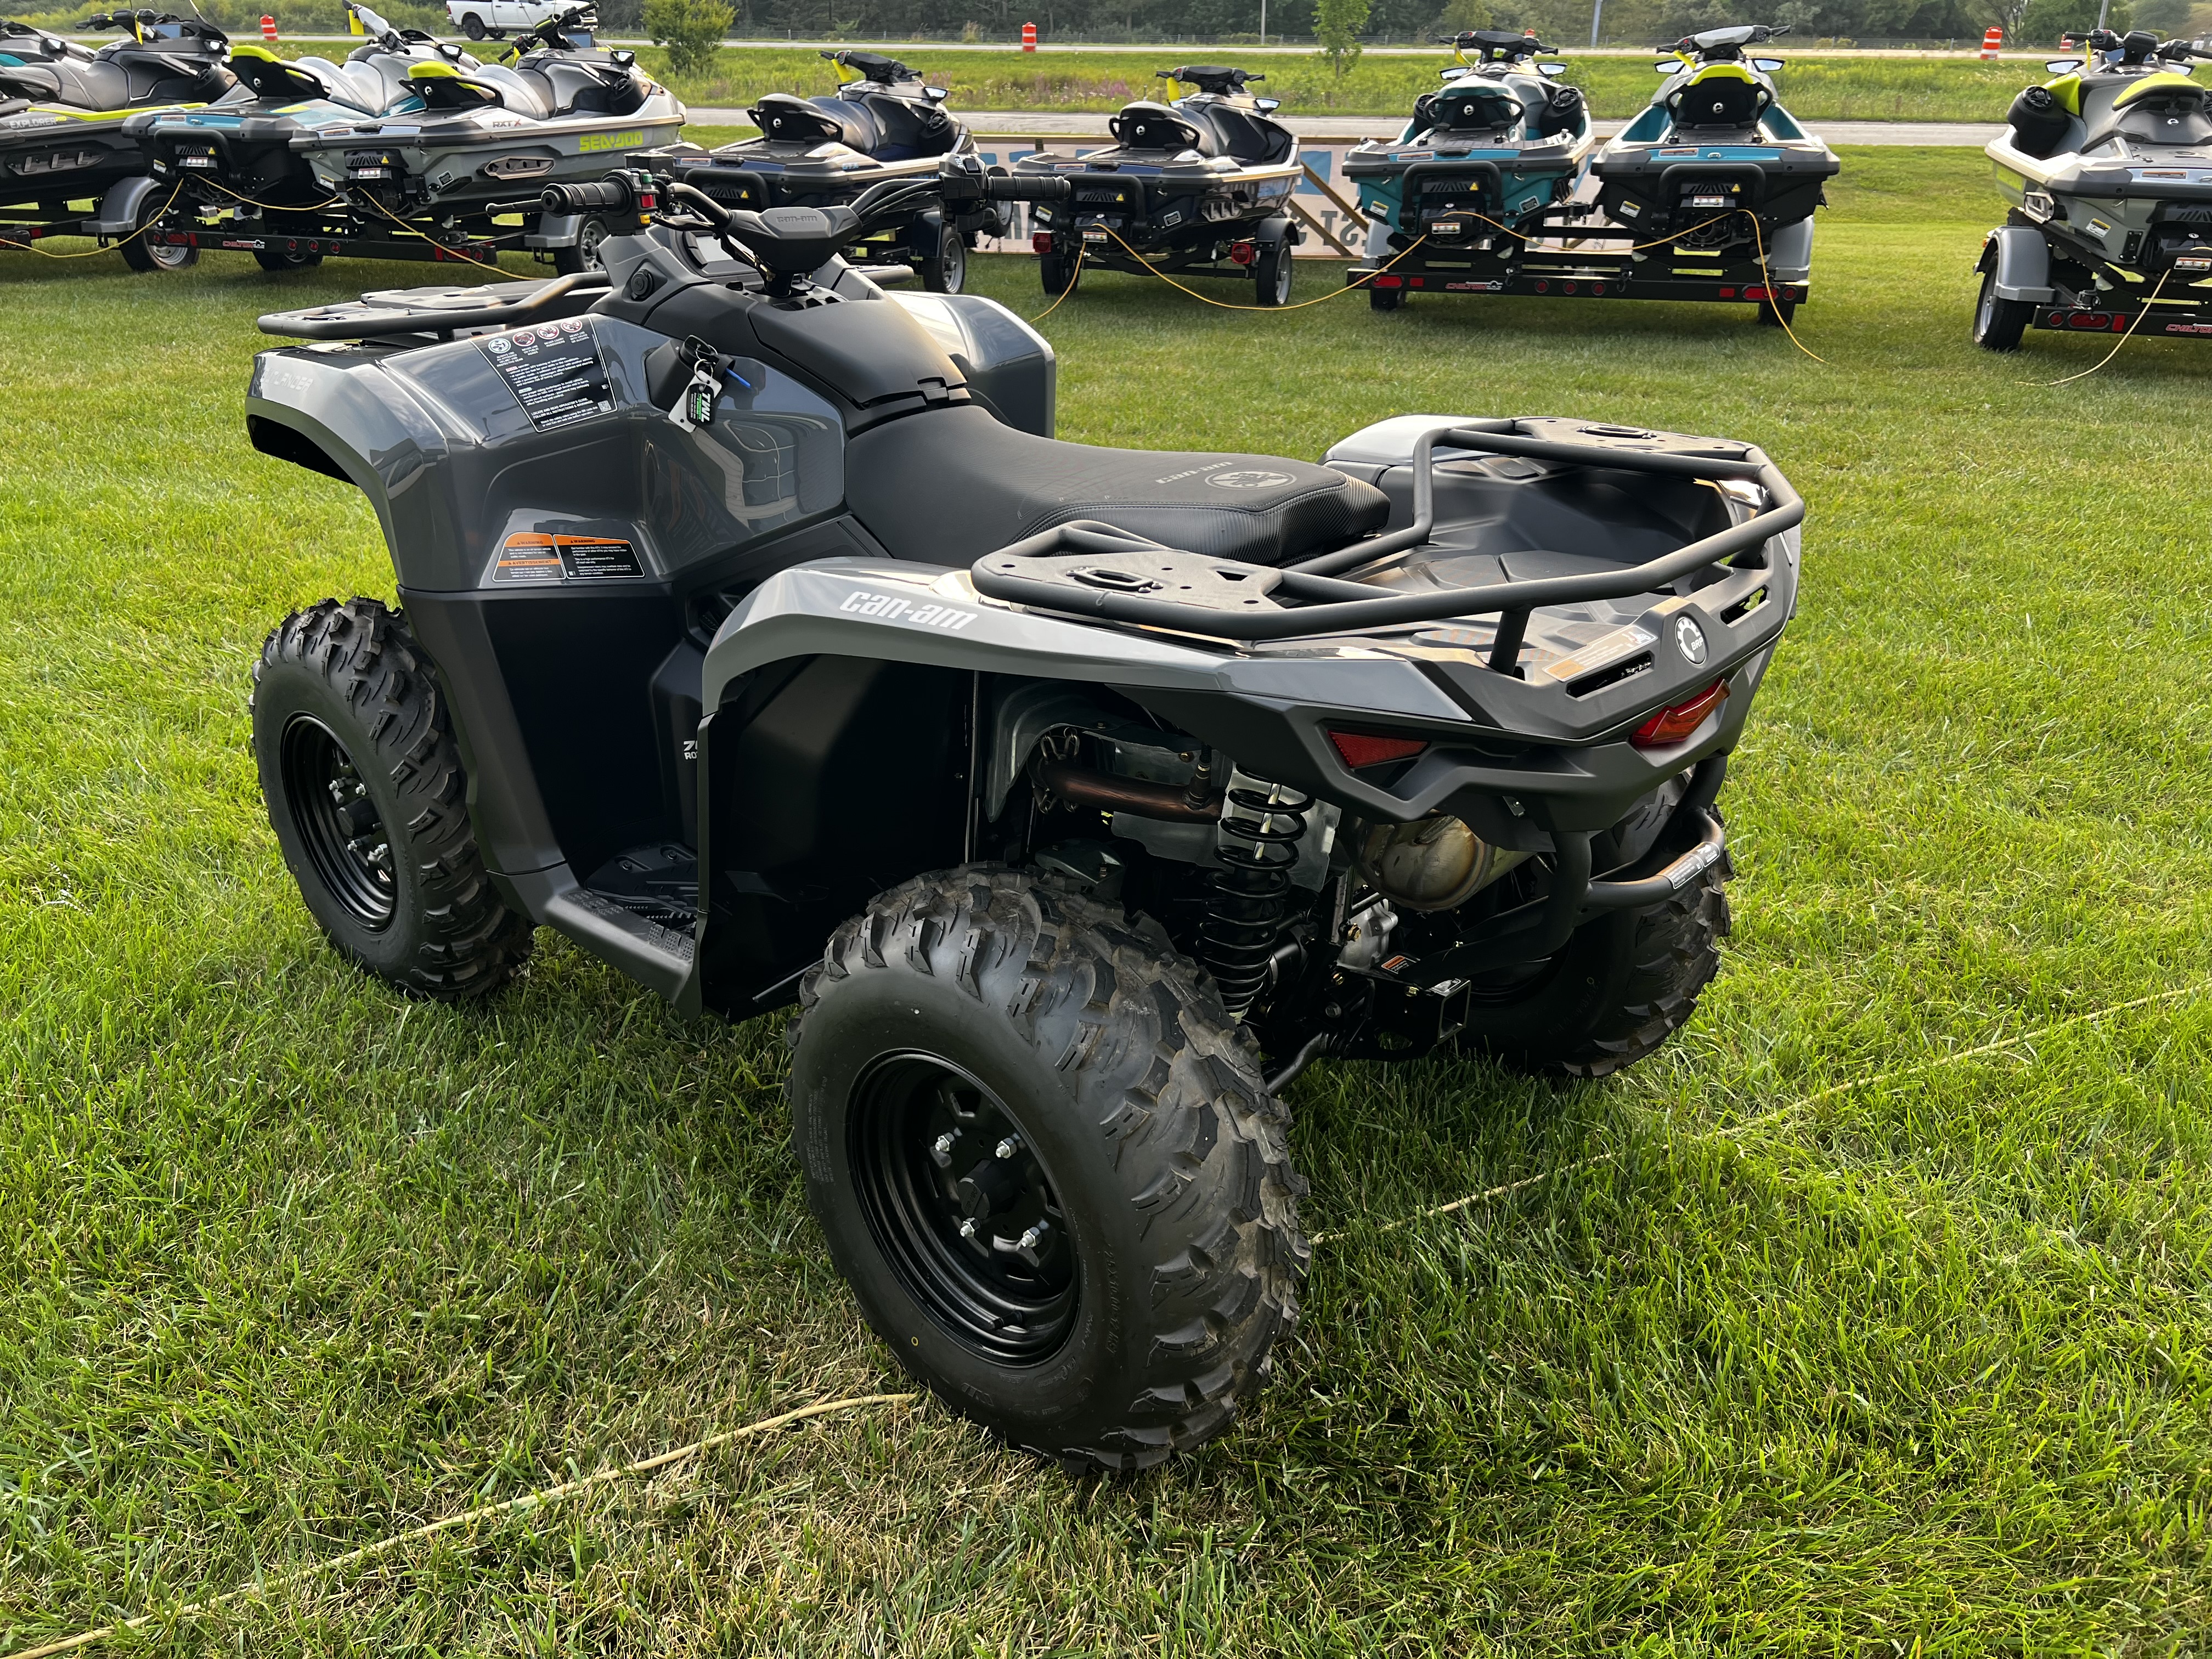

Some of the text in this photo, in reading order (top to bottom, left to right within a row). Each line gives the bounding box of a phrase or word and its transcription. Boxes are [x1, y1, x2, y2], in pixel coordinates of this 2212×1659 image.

[9, 117, 57, 129] EXPLORER
[2165, 324, 2212, 334] CHILTO
[702, 393, 710, 422] TWL
[1155, 462, 1233, 484] can-am
[840, 591, 978, 630] can-am
[1691, 636, 1703, 651] BRP
[684, 740, 698, 752] 7
[684, 751, 698, 760] RO
